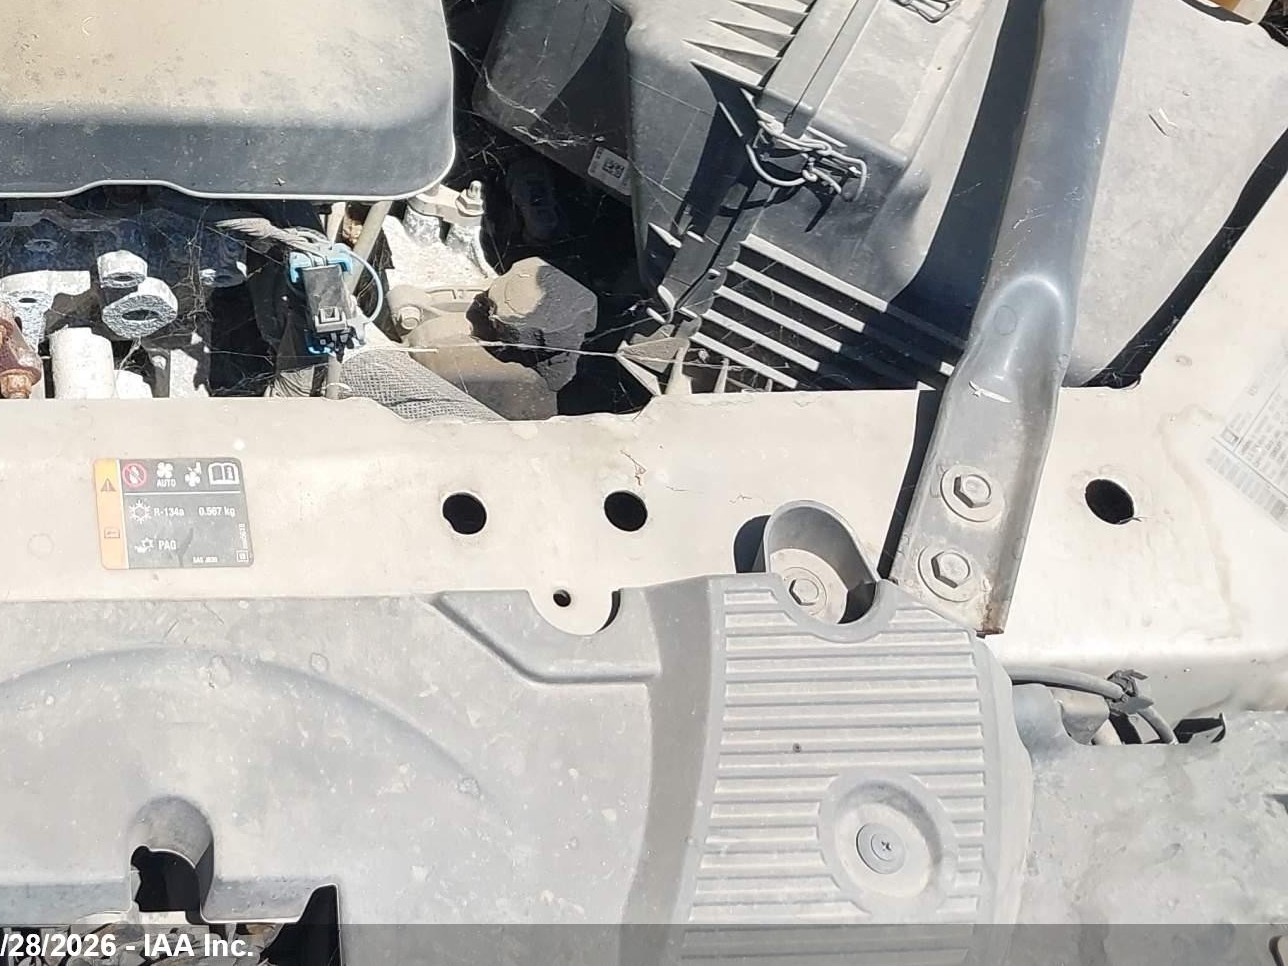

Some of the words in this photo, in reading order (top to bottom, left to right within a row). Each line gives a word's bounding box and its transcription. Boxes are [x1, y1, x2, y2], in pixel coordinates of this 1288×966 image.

[156, 478, 177, 488] AUTO
[153, 507, 185, 517] R-134a
[224, 505, 236, 518] kg
[158, 539, 177, 551] PAG
